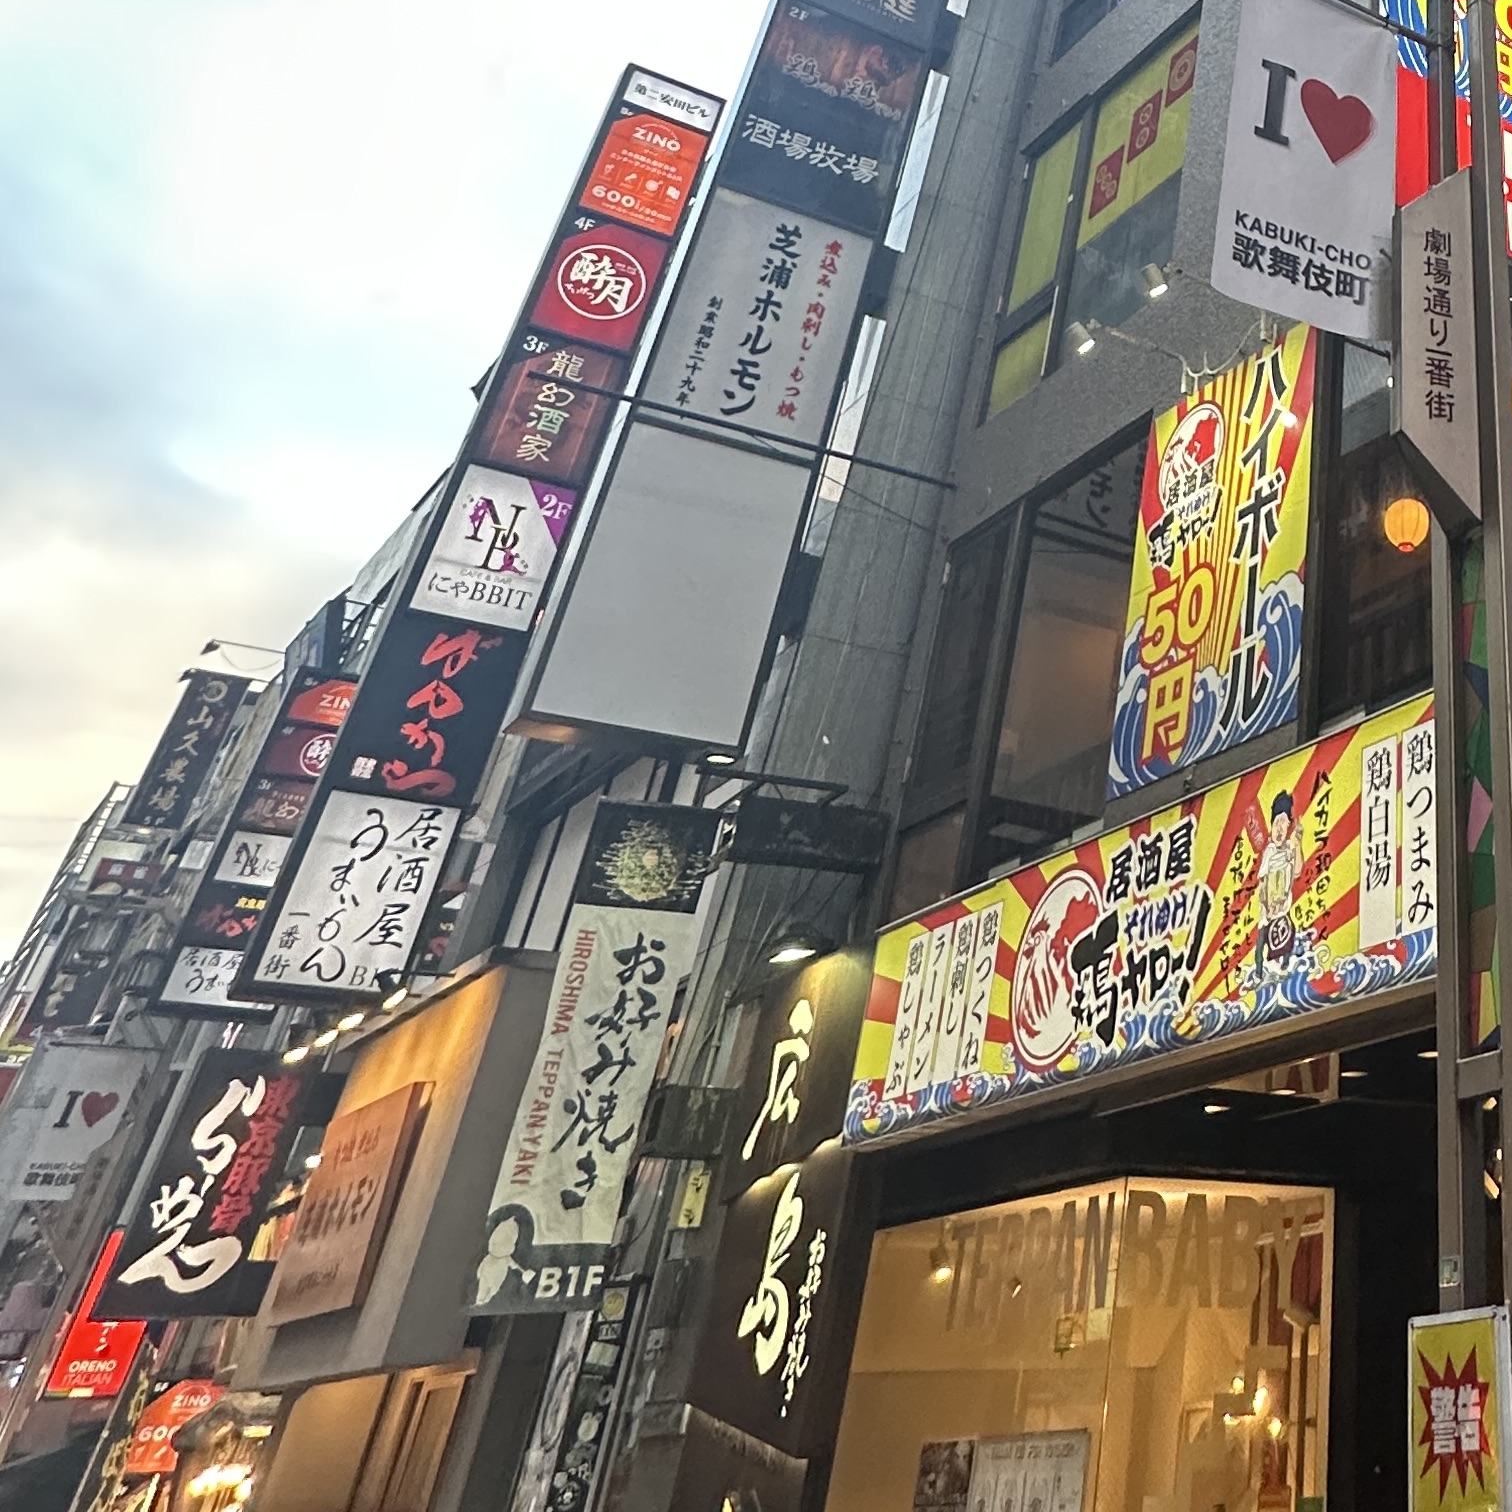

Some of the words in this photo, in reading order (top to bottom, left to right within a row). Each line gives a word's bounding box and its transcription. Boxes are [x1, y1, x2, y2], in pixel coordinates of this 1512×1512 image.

[632, 126, 681, 152] ZINO
[1253, 58, 1297, 147] I
[741, 113, 879, 185] 酒場牧場
[573, 216, 596, 231] 4F
[1234, 209, 1372, 270] KABUKI-CHO
[569, 251, 633, 314] 酔月
[1231, 231, 1372, 305] 歌舞伎町
[522, 334, 550, 355] 3F
[719, 223, 803, 416] 芝浦ホルモン
[1422, 226, 1456, 424] 劇場通り一番街
[516, 350, 585, 463] 龍幻酒家
[541, 494, 573, 521] 2F
[1218, 346, 1290, 738] ハイボール
[1105, 818, 1195, 904] 居酒屋
[1365, 747, 1393, 893] 鶏白湯
[1406, 728, 1434, 925] 鶏つまみ
[353, 808, 442, 949] 居酒屋
[264, 910, 311, 979] 一番街
[550, 928, 598, 1036] HIROSHIMA
[913, 932, 946, 1080] ラーメン
[961, 909, 999, 1070] 鶏つくね
[549, 931, 666, 1211] お好み焼き
[534, 1264, 605, 1299] B1F
[68, 1359, 119, 1373] ORENO
[172, 1394, 211, 1408] ZINO
